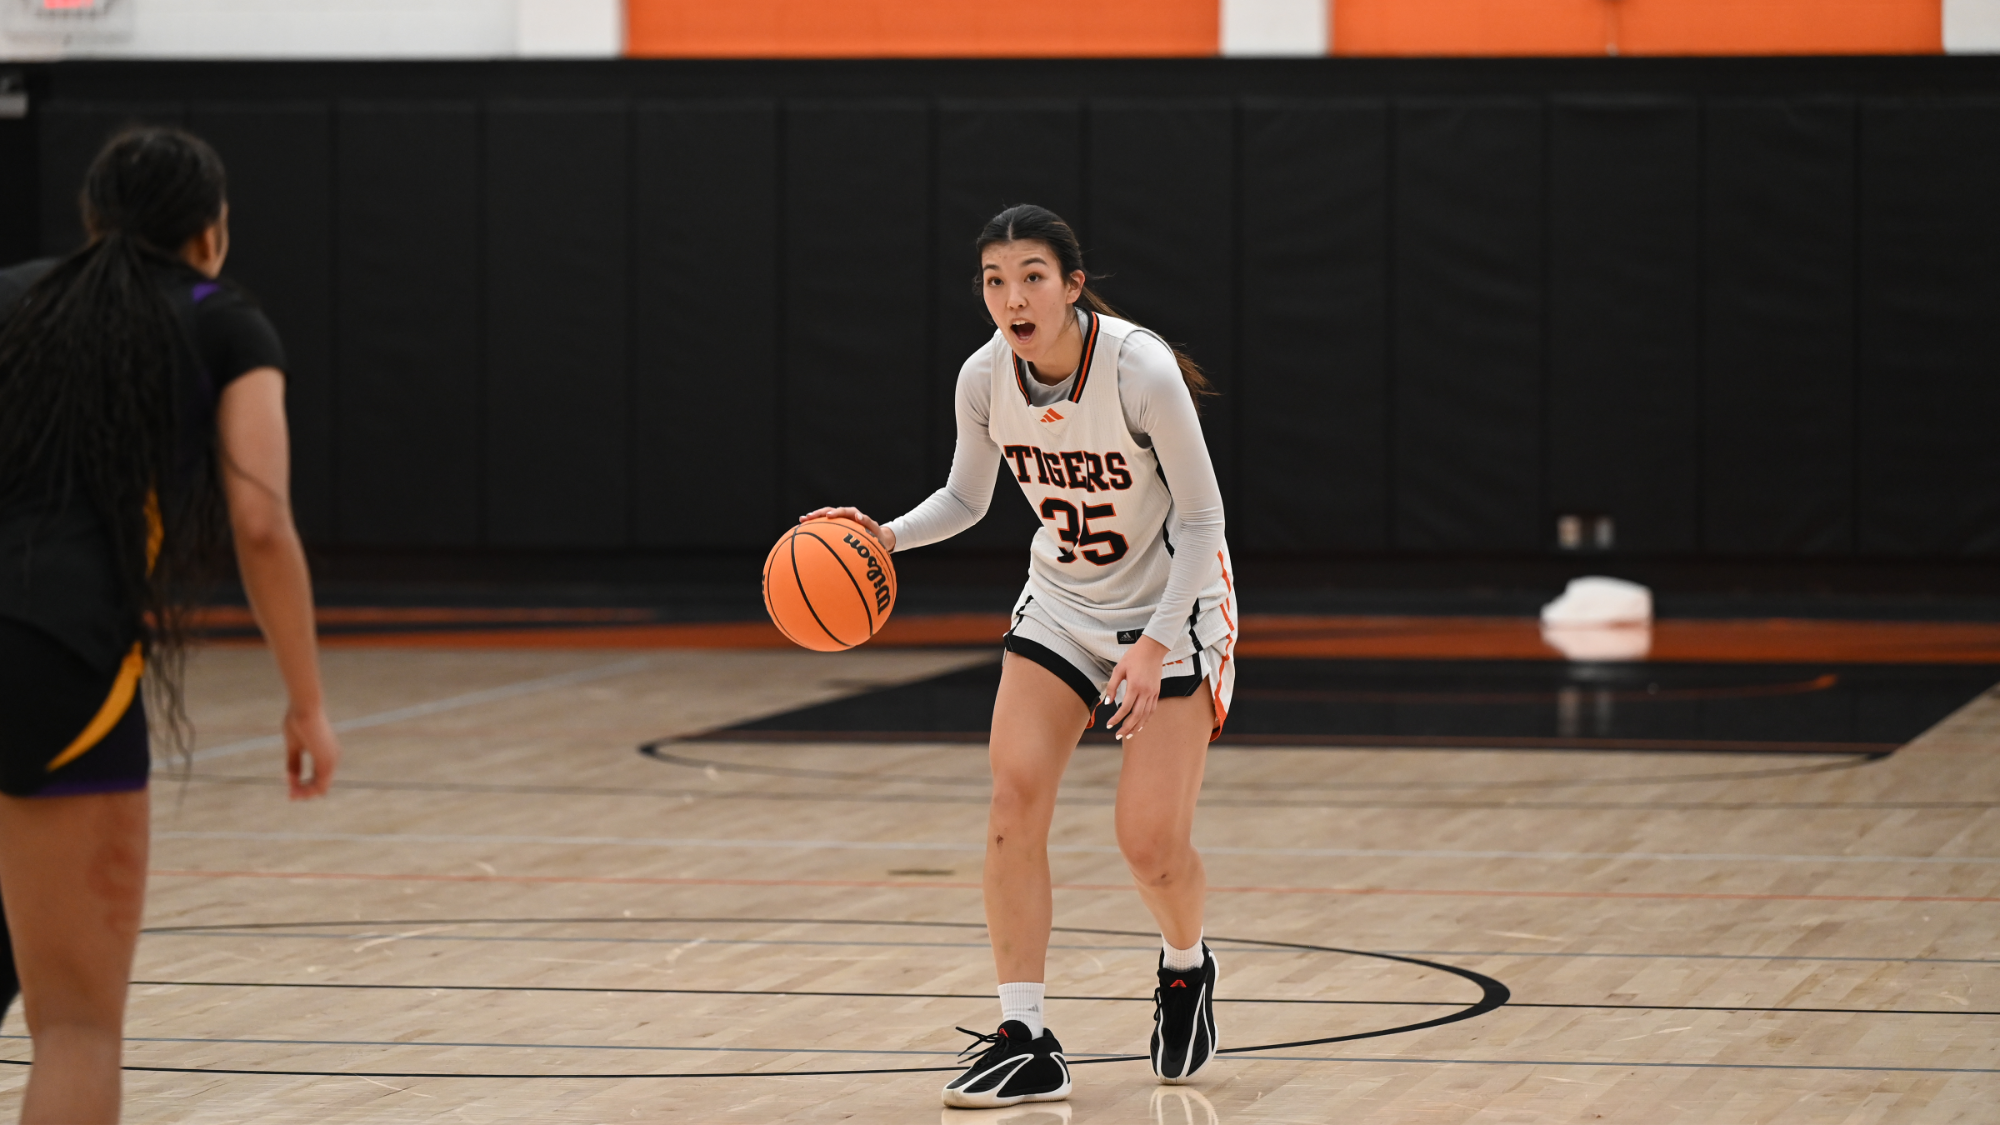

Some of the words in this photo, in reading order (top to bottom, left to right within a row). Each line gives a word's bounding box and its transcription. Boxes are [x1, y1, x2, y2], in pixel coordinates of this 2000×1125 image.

[1003, 444, 1133, 493] TIGERS
[1039, 496, 1130, 567] 35
[843, 533, 891, 616] Wilson
